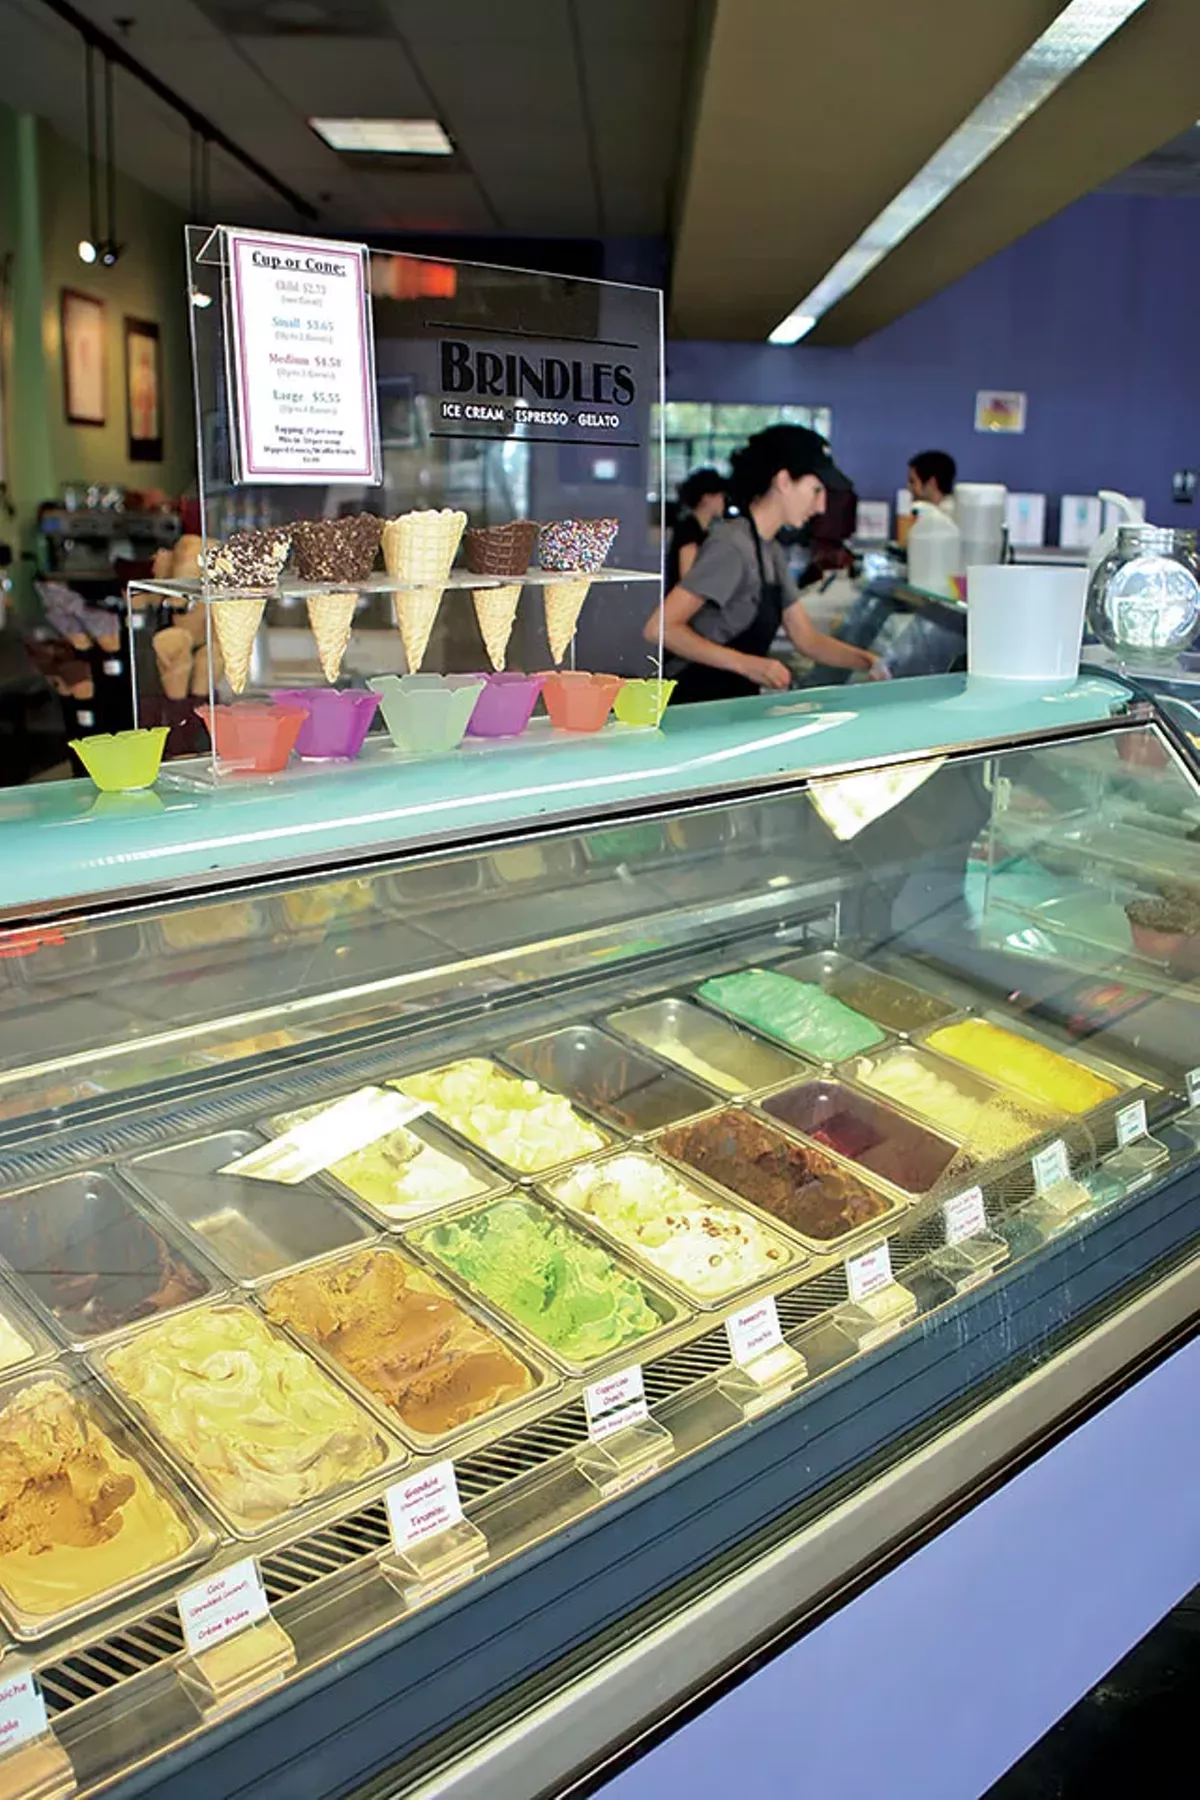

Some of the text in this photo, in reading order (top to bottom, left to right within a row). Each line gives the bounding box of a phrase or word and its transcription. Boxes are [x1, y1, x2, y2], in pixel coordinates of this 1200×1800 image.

[252, 250, 347, 278] Cup or Cone:
[269, 352, 310, 366] Medium
[441, 341, 635, 406] BRINDLES
[273, 389, 304, 403] Large
[442, 403, 620, 428] ICE CREAM ESPRESSO GELATO
